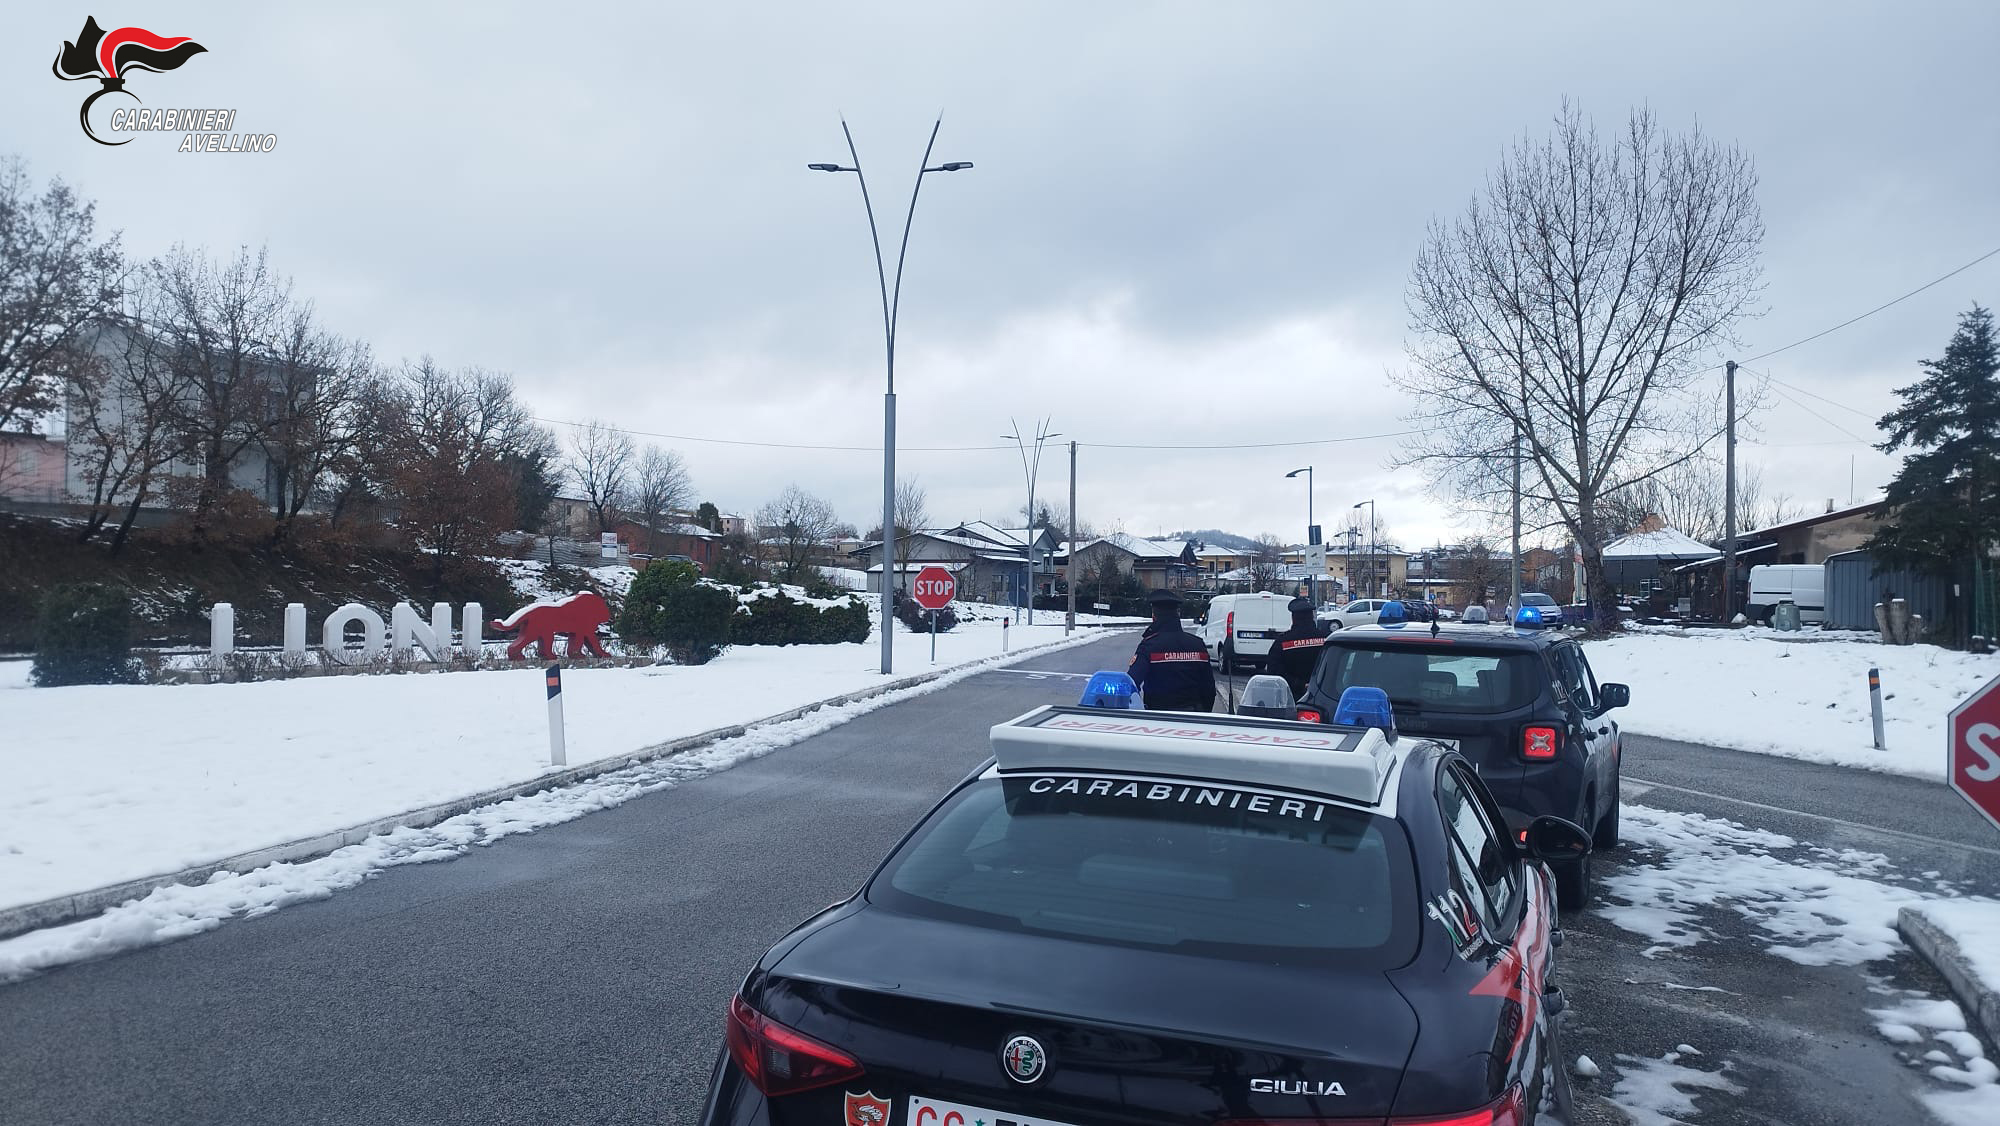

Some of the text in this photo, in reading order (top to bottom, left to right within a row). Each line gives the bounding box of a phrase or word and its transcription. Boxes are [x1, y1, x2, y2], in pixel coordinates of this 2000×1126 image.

[916, 580, 954, 596] STOP
[1164, 651, 1201, 660] CARABINIERI
[1048, 720, 1332, 746] CARABINIERI
[1028, 777, 1326, 822] CARABINIERI
[1426, 888, 1480, 948] 112
[1250, 1078, 1347, 1096] GIULIA
